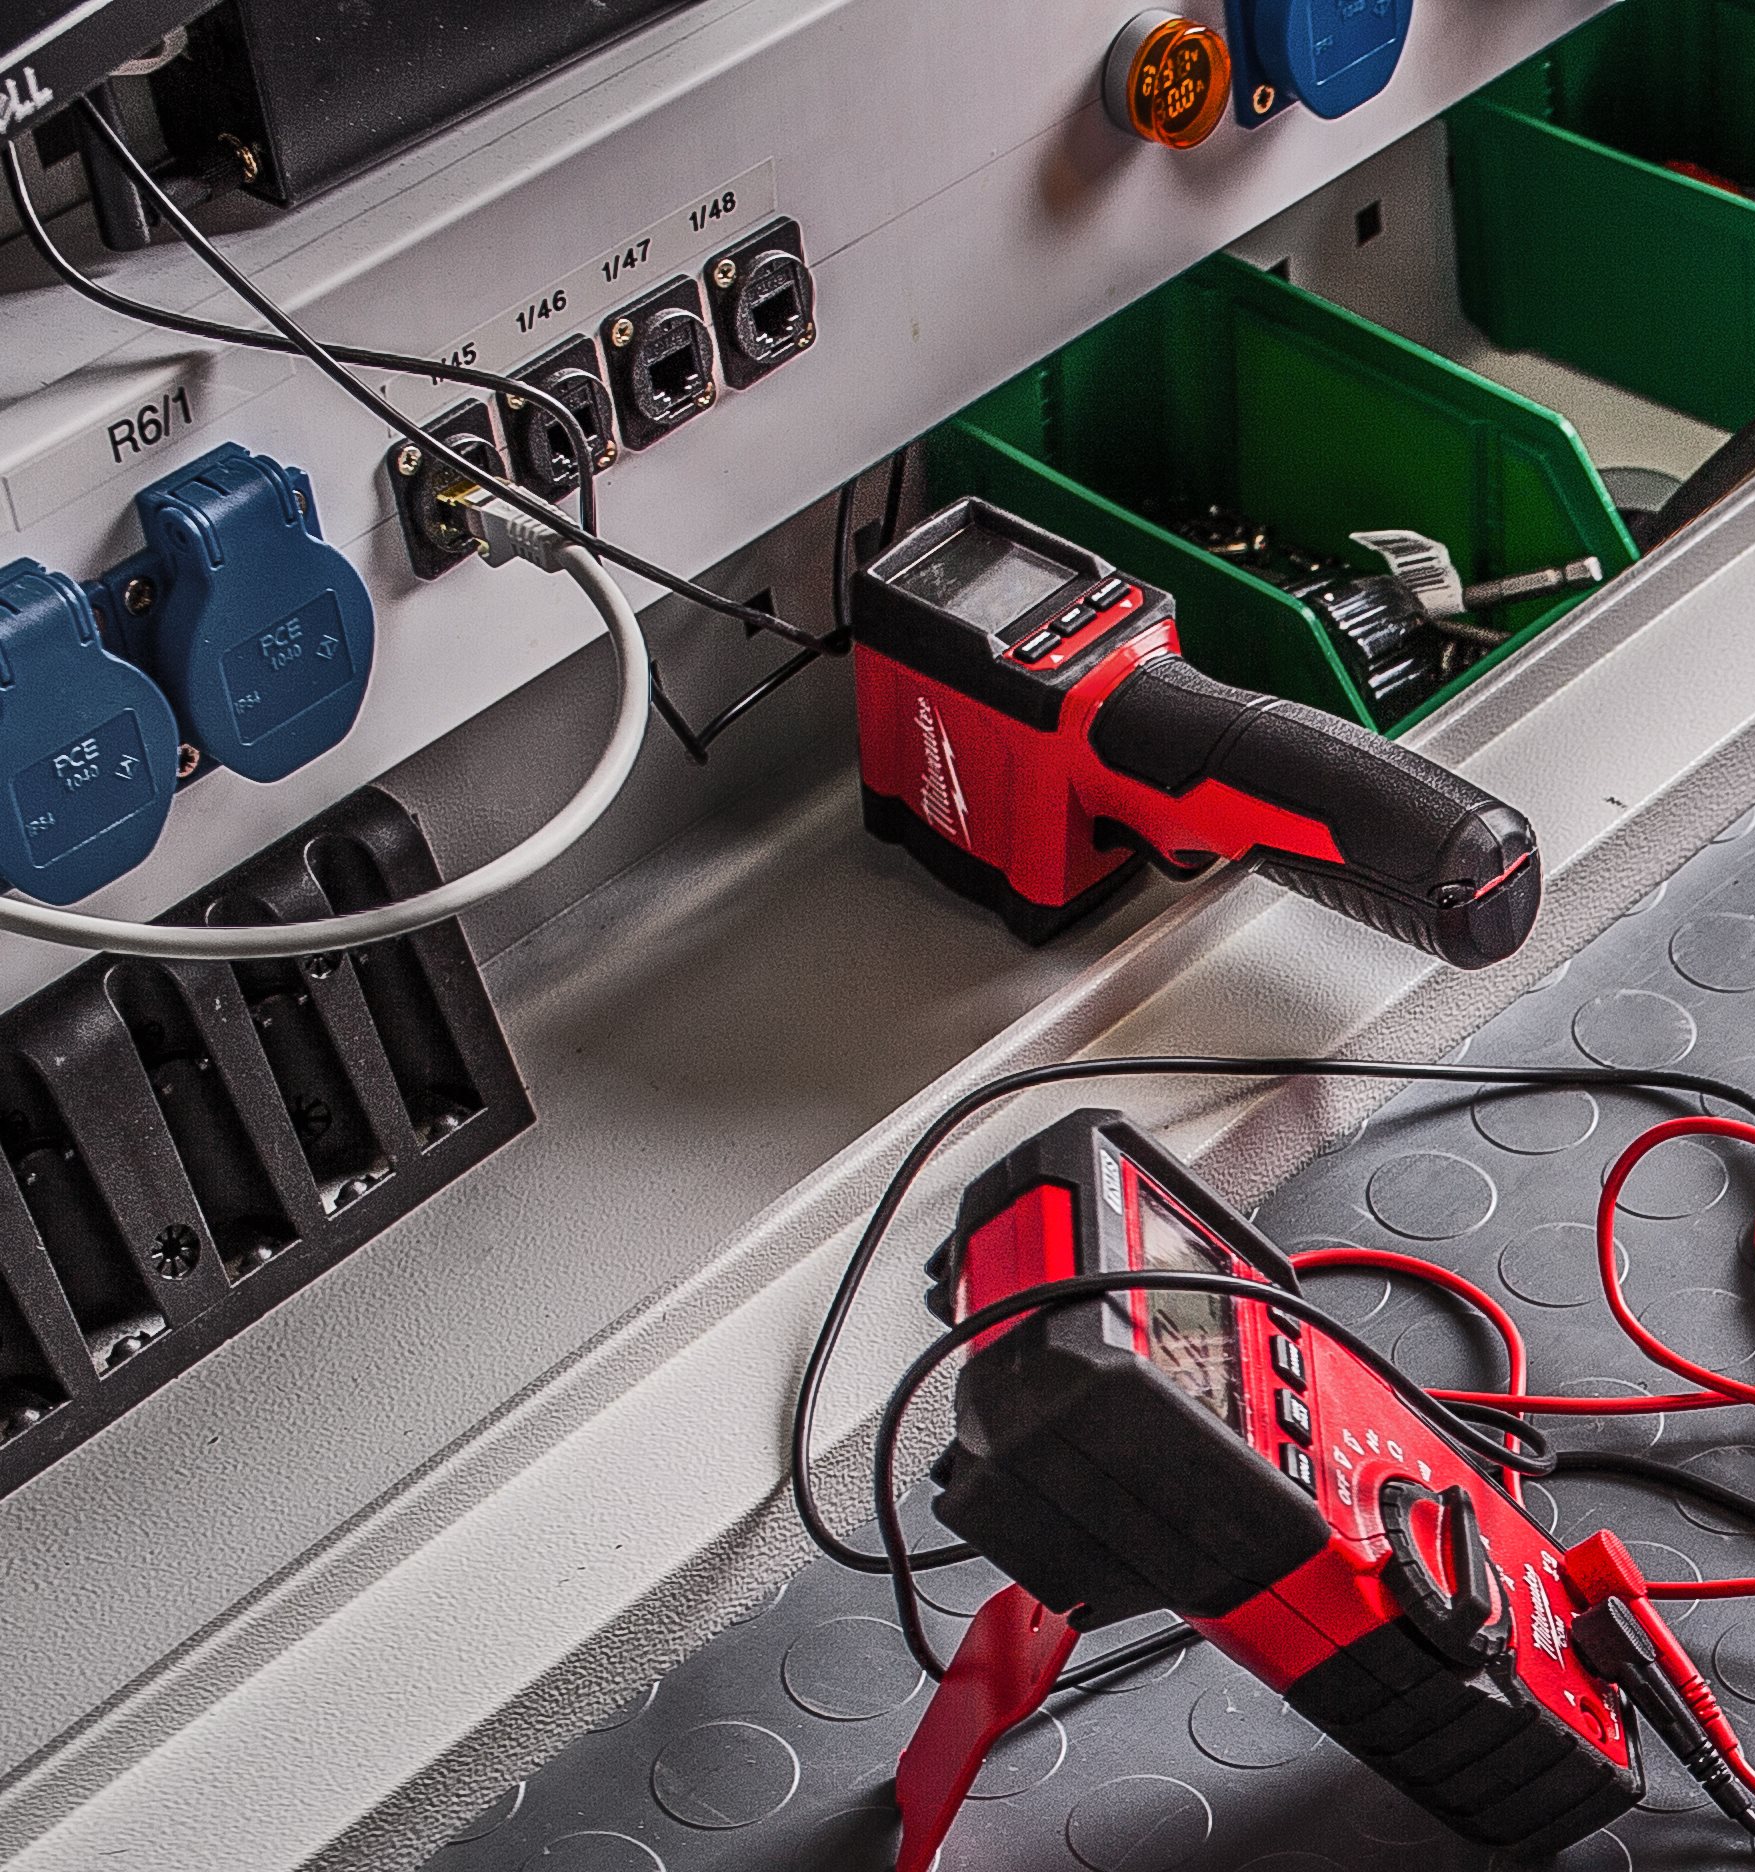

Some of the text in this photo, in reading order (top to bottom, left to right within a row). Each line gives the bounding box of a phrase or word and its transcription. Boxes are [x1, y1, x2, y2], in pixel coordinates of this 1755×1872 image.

[689, 191, 736, 231] 1/48
[602, 238, 651, 282] 1/47
[515, 289, 567, 333] 1/46
[107, 386, 193, 464] R6/1
[259, 616, 304, 657] PCE
[52, 737, 100, 778] PCE
[914, 696, 957, 836] Milwaukee
[1336, 1468, 1352, 1506] OFF
[1523, 1562, 1558, 1661] Milwaukee
